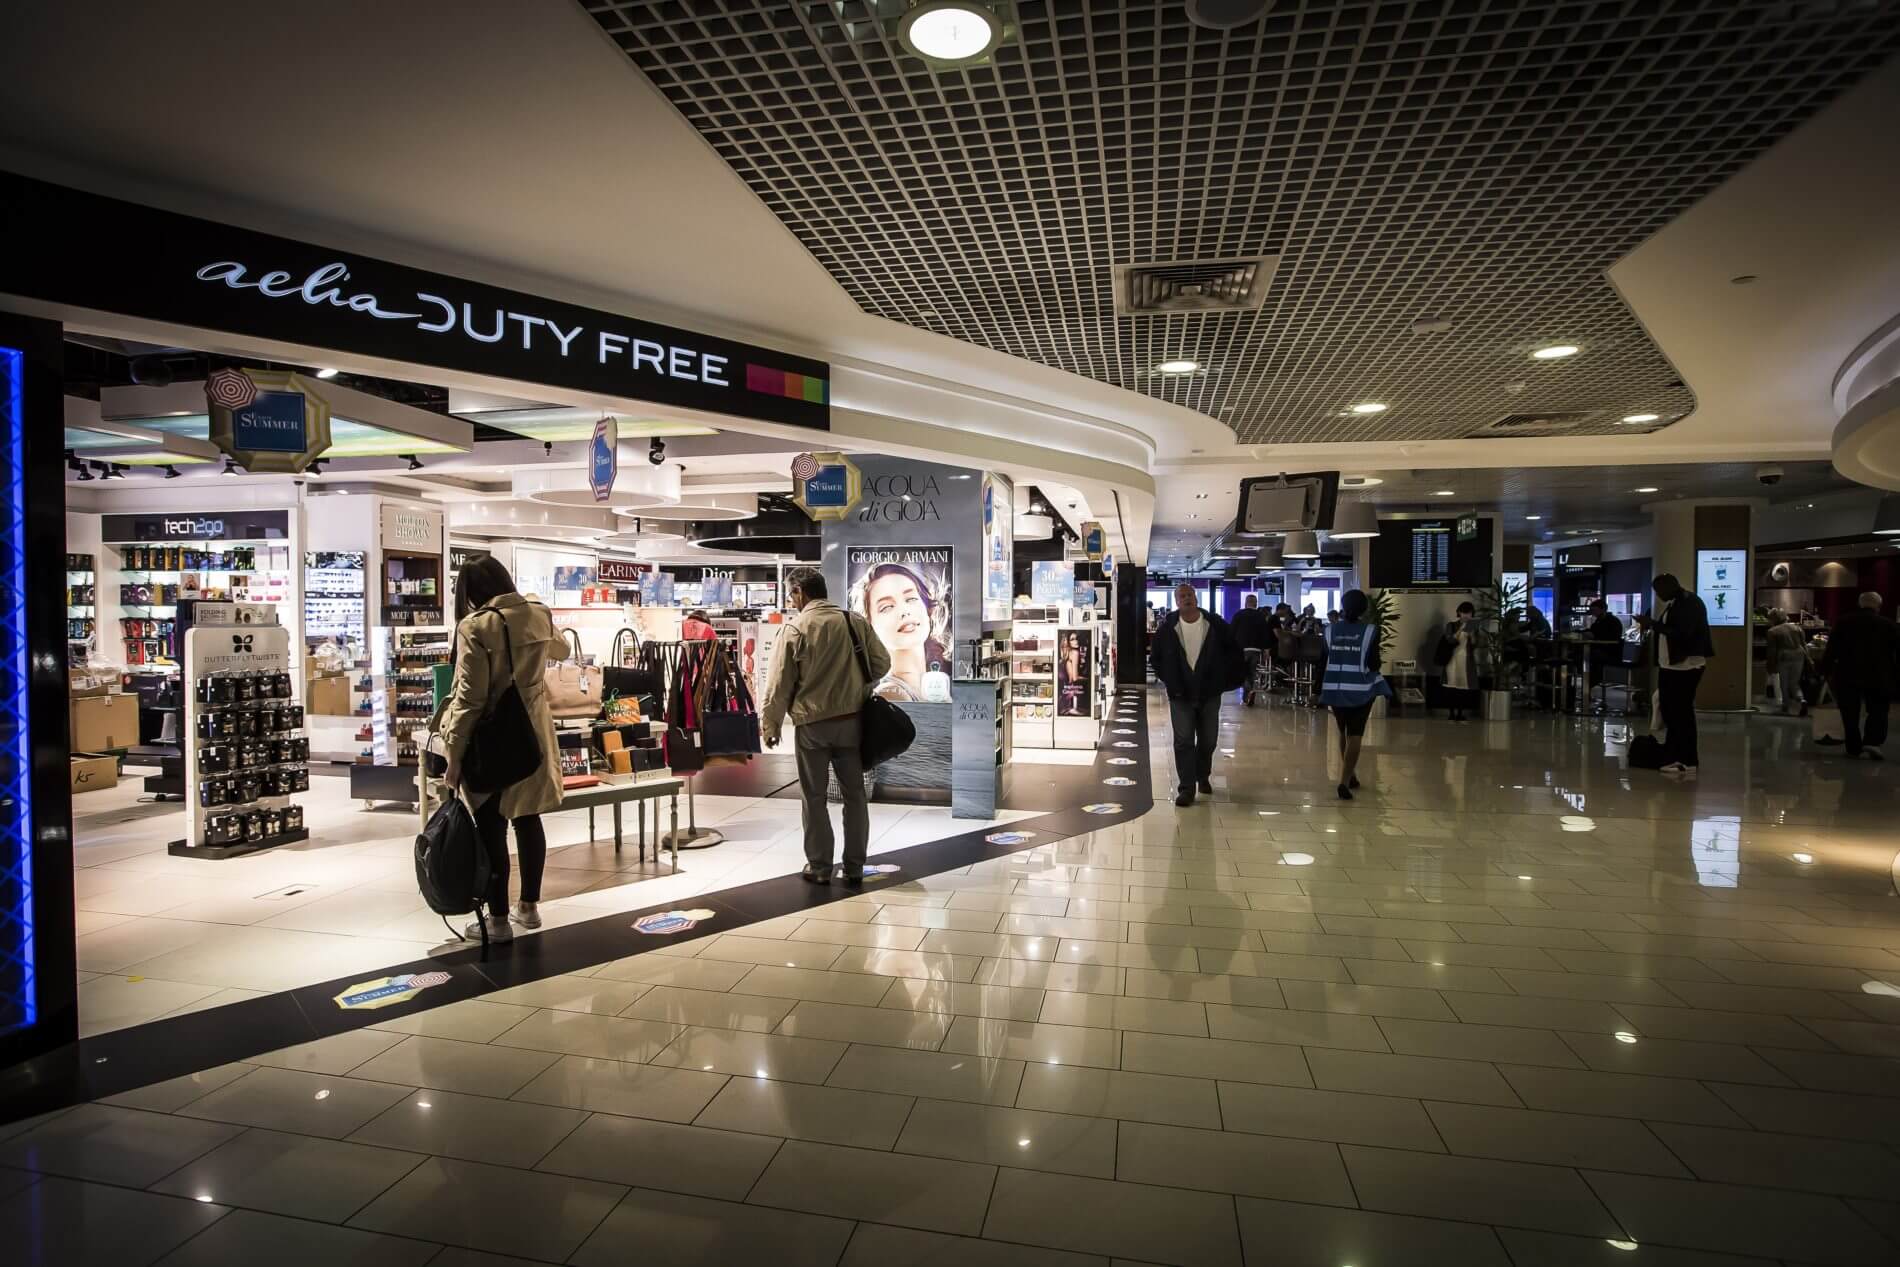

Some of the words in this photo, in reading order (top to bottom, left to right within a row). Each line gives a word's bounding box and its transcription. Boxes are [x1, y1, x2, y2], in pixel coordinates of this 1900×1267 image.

[196, 261, 421, 319] aelia
[416, 292, 584, 356] DUTY
[599, 332, 729, 387] FREE
[862, 475, 941, 498] ACQUA
[859, 501, 880, 522] di
[882, 501, 941, 522] GIOIA
[165, 518, 224, 537] tech2go
[851, 551, 899, 565] GIORGIO
[903, 551, 949, 563] ARMANI
[600, 563, 645, 578] LARINS
[702, 567, 736, 580] Dior
